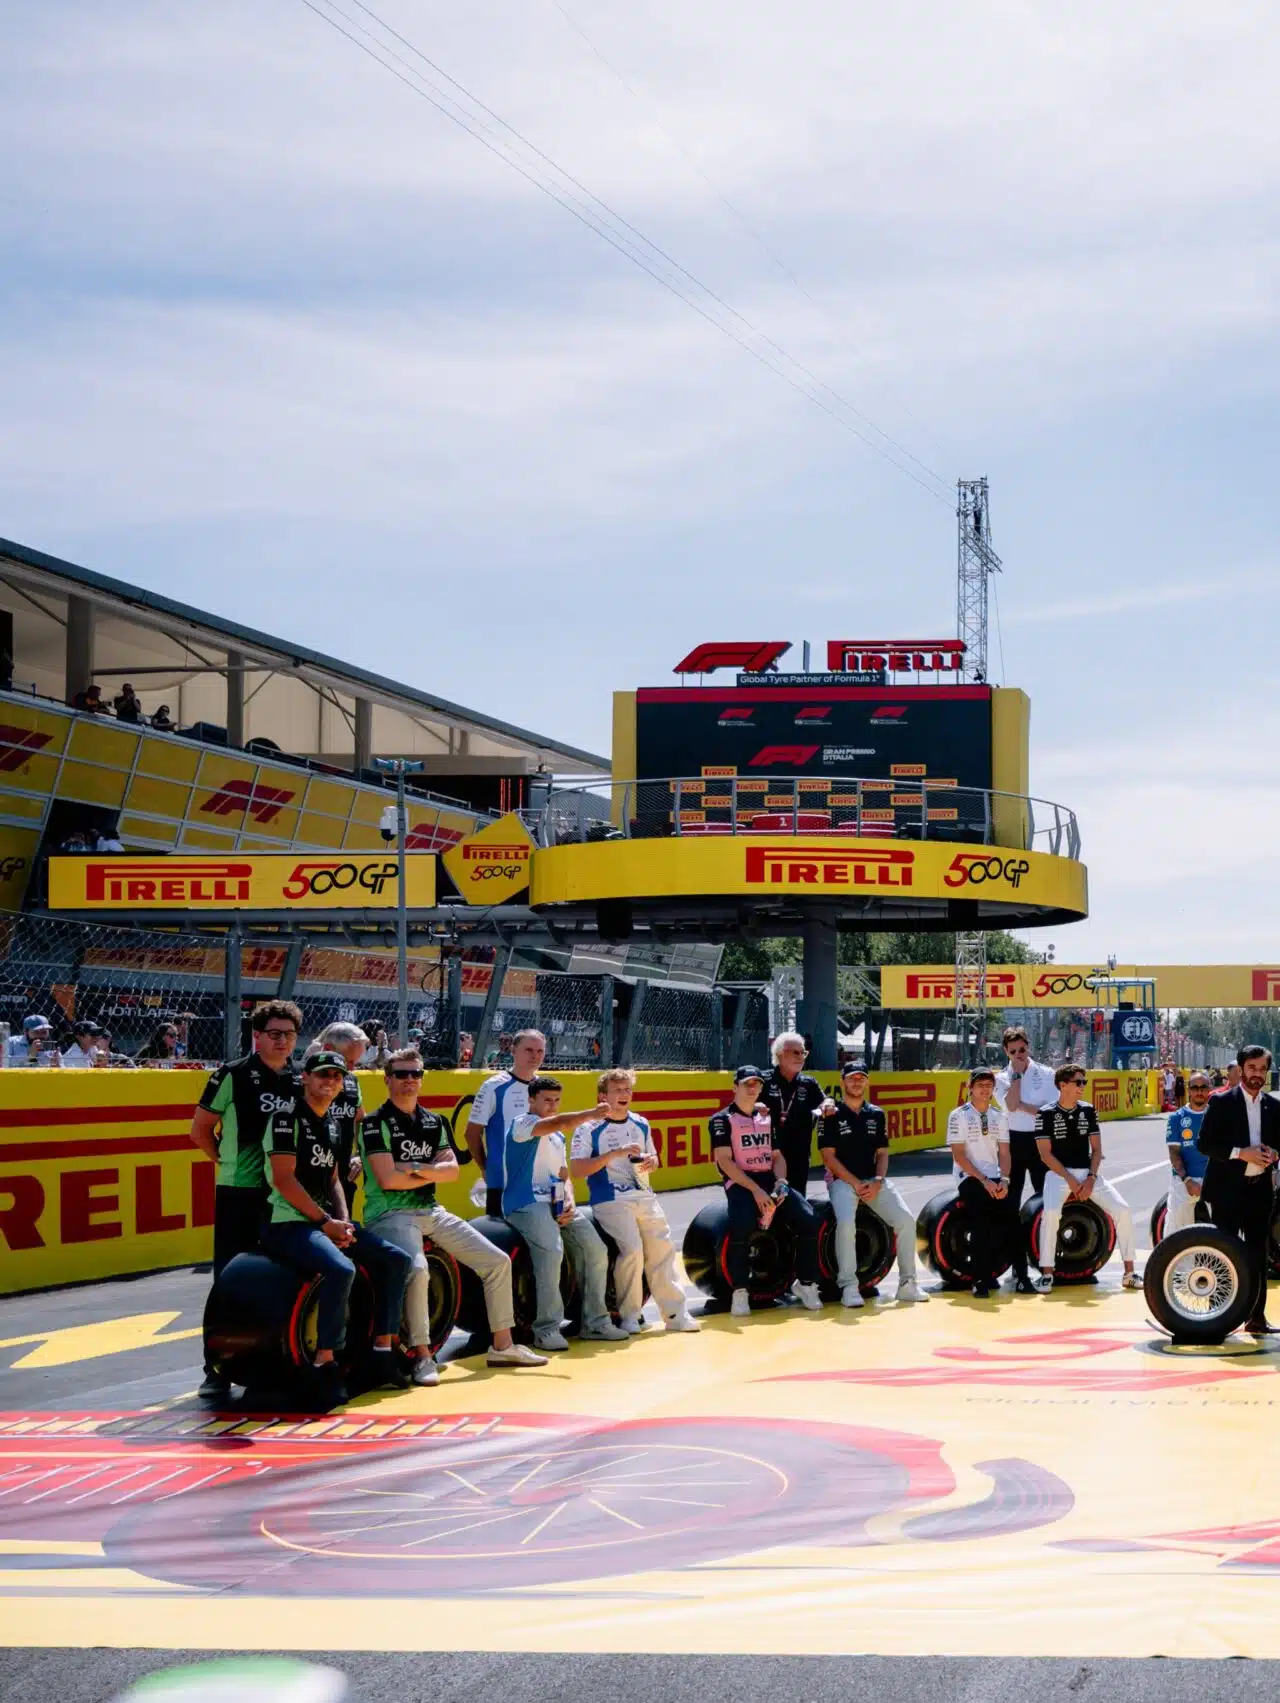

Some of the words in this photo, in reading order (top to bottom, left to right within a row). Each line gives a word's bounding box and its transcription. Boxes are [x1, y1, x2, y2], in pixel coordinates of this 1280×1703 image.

[827, 640, 967, 672] PIRELLI
[740, 674, 768, 683] Global
[769, 674, 789, 684] Tyre
[790, 674, 822, 683] Partner
[824, 674, 833, 683] of
[834, 674, 870, 683] Formula
[463, 844, 529, 860] PIRELLI
[746, 846, 915, 886] PIRELLI
[86, 864, 252, 901] PIRELLI
[1124, 1022, 1151, 1037] FIA
[1092, 1078, 1119, 1113] PIRELLI
[328, 1101, 355, 1118] take
[400, 1140, 433, 1161] Stake
